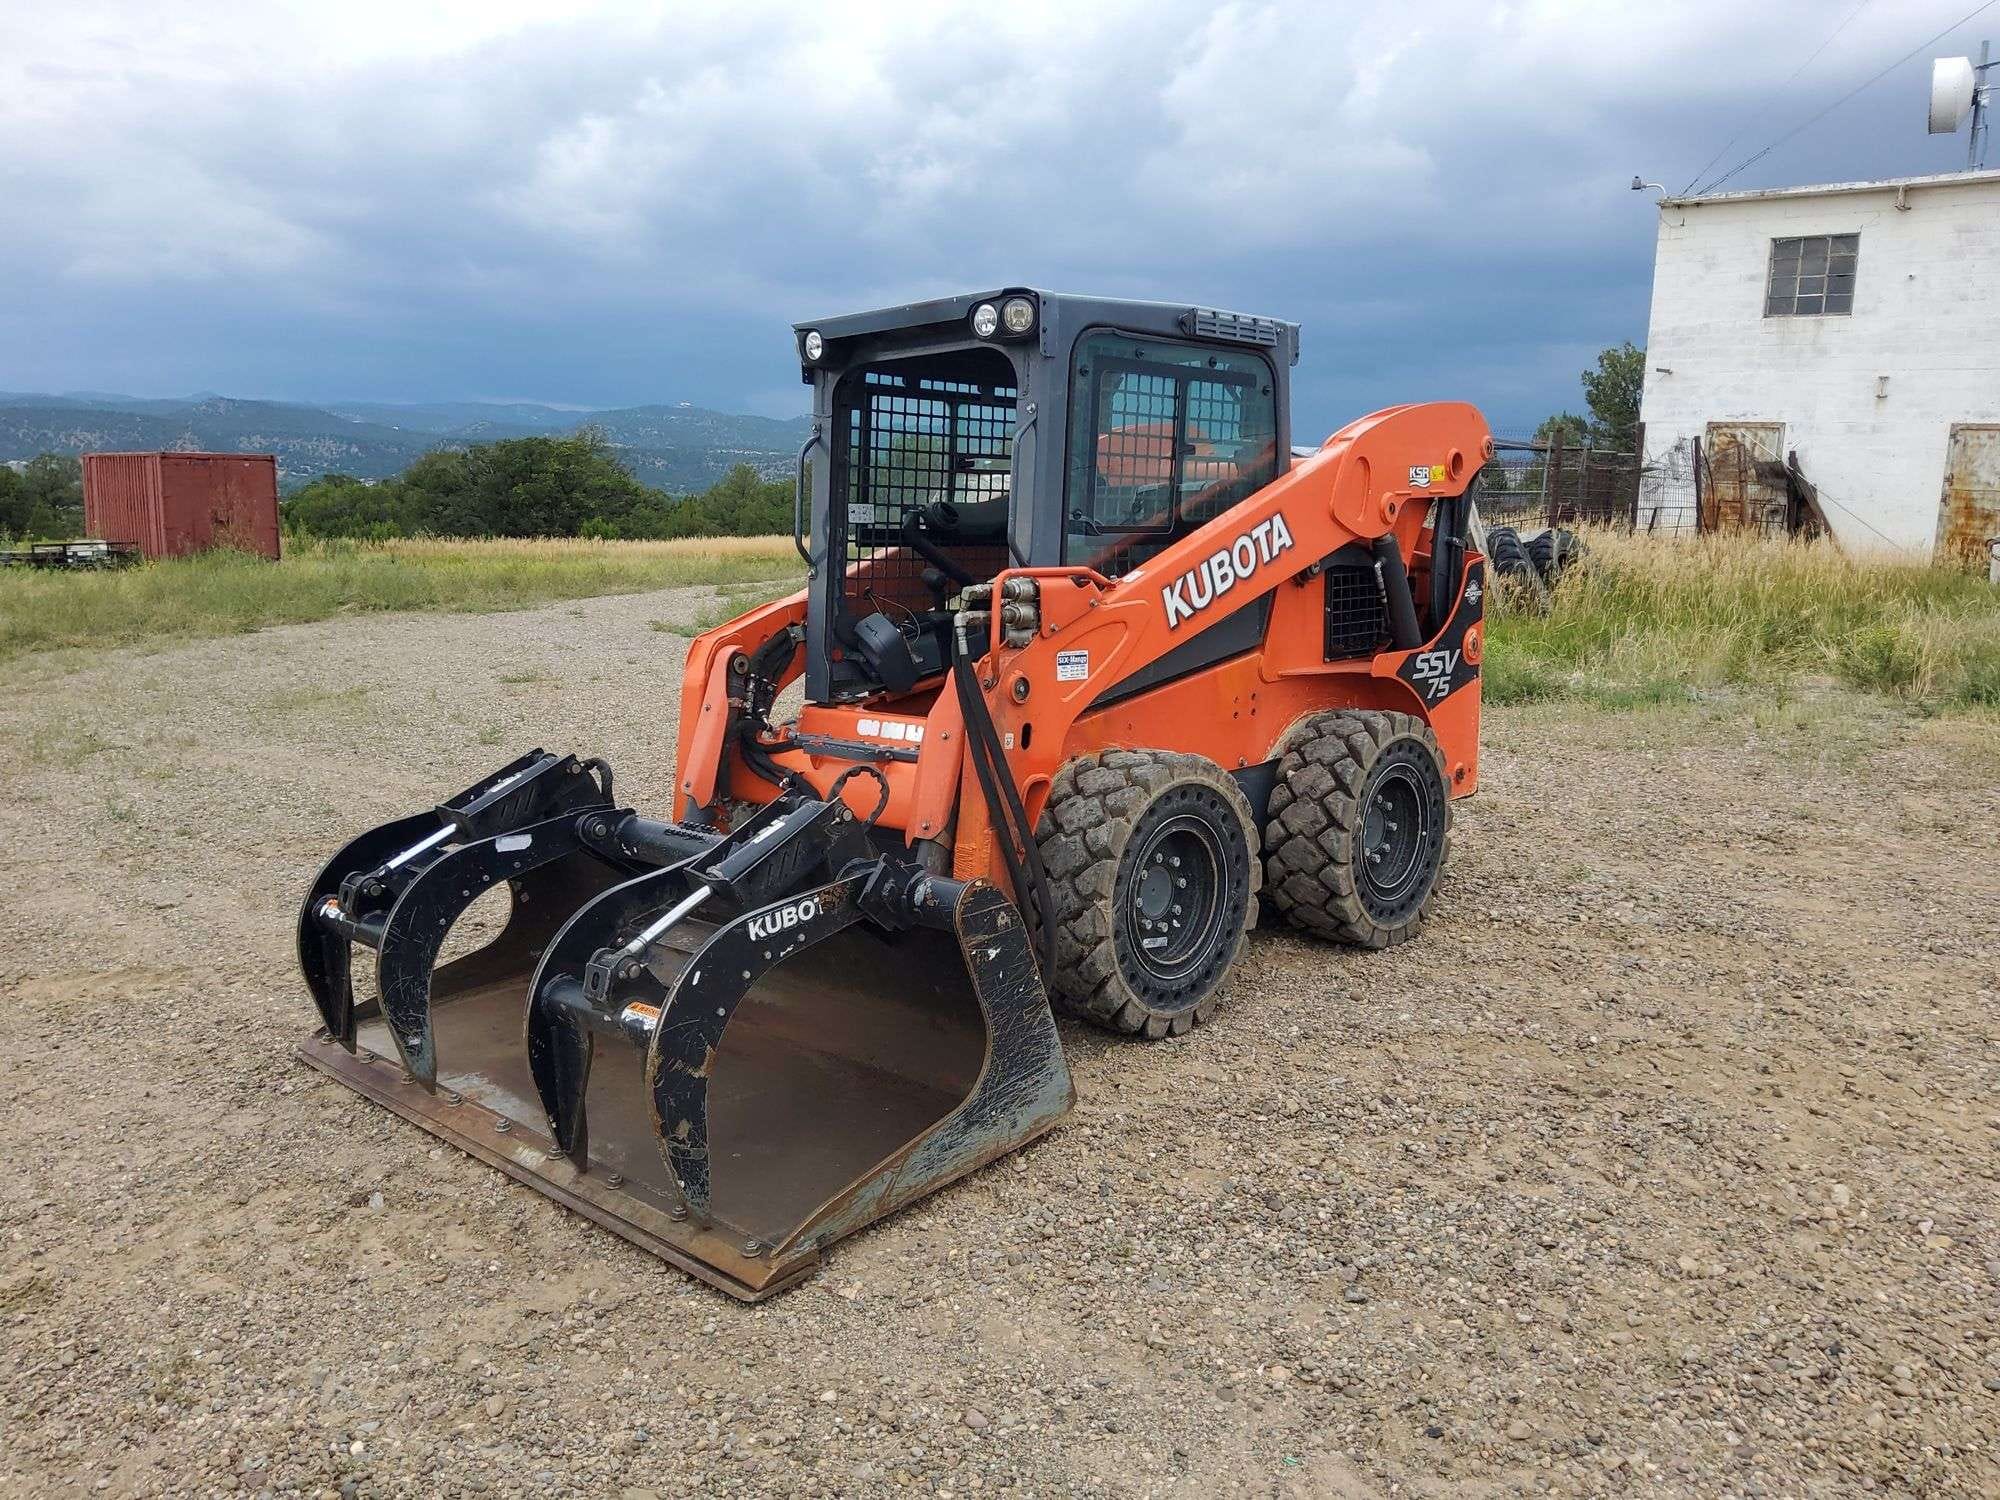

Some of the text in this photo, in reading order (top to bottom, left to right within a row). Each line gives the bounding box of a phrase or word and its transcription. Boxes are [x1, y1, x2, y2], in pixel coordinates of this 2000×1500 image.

[1408, 466, 1429, 478] KSR
[1162, 512, 1294, 630] KUBOTA
[1412, 649, 1461, 679] SSV
[1427, 676, 1451, 698] 75
